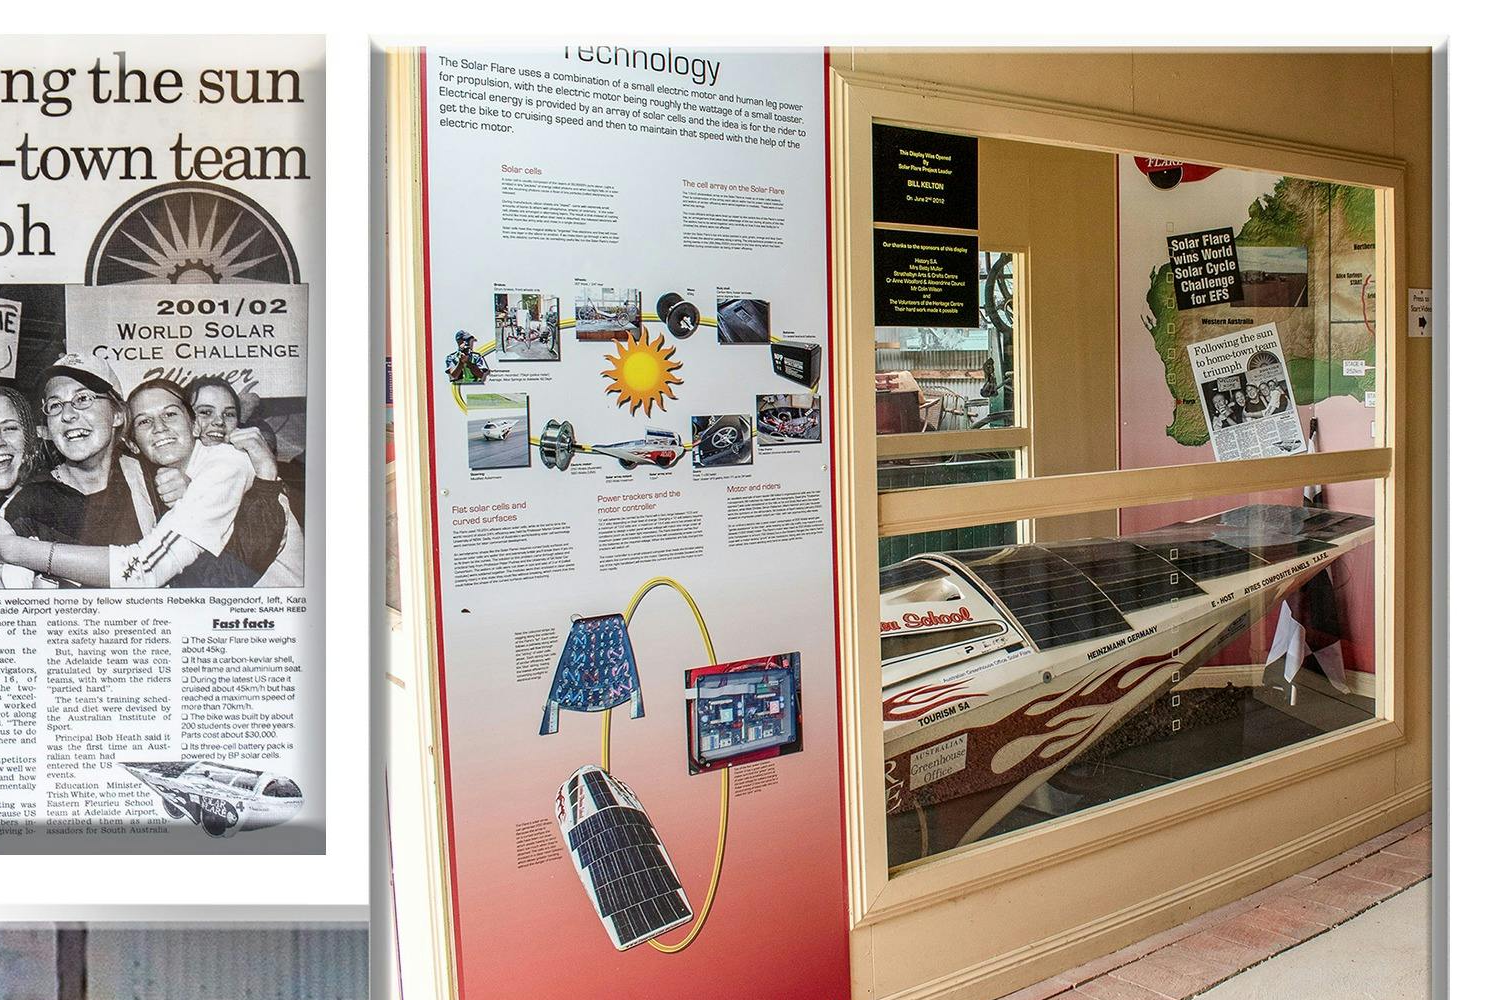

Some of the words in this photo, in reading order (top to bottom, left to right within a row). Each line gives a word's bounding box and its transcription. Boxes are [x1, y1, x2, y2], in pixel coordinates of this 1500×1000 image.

[87, 51, 183, 104] the
[199, 69, 304, 104] sun
[438, 55, 458, 67] The
[460, 58, 488, 70] Solar
[490, 62, 515, 74] Flare
[518, 68, 541, 78] uses
[543, 71, 550, 79] a
[552, 72, 609, 86] combination
[611, 78, 621, 87] of
[623, 81, 629, 89] a
[631, 82, 654, 92] small
[656, 84, 689, 96] electric
[690, 90, 717, 100] motor
[718, 94, 734, 102] and
[735, 94, 764, 106] human
[765, 98, 777, 110] leg
[778, 102, 803, 111] power
[169, 132, 311, 182] team
[501, 164, 523, 173] Solar
[524, 167, 542, 175] cells
[682, 179, 695, 187] The
[709, 183, 727, 192] array
[738, 184, 749, 192] the
[750, 184, 768, 193] Solar
[768, 186, 785, 195] Flare
[1171, 238, 1200, 251] Solar
[1202, 232, 1231, 246] Flare
[1174, 252, 1199, 265] wins
[1201, 245, 1233, 260] World
[1175, 267, 1203, 280] Solar
[1206, 260, 1236, 276] Cycle
[1181, 274, 1235, 293] Challenge
[1191, 293, 1206, 305] for
[1209, 288, 1229, 302] EFS
[157, 297, 287, 317] 2001/02
[116, 323, 192, 340] WORLD
[204, 321, 274, 338] SOLAR
[93, 345, 163, 361] CYCLE
[175, 343, 299, 359] CHALLENGE
[1194, 338, 1239, 356] Following
[1239, 333, 1256, 345] the
[1257, 329, 1273, 339] sun
[1196, 358, 1206, 368] to
[1206, 347, 1254, 367] home-town
[1255, 341, 1277, 353] team
[1203, 361, 1242, 379] triumph
[748, 483, 761, 491] and
[761, 482, 781, 490] riders
[597, 495, 621, 503] Power
[622, 492, 653, 501] trackers
[654, 490, 667, 499] and
[451, 505, 468, 514] Flat
[469, 504, 491, 513] solar
[491, 502, 510, 511] cells
[511, 501, 526, 509] and
[452, 516, 480, 526] curved
[482, 514, 517, 523] surfaces
[1244, 581, 1262, 595] AYRES
[1261, 569, 1291, 587] COMPOSITE
[1291, 561, 1310, 574] PANELS
[4, 597, 50, 605] welcomed
[53, 597, 79, 605] home
[82, 597, 93, 606] by
[96, 597, 122, 605] fellow
[166, 596, 205, 604] Rebekka
[209, 596, 263, 606] Baggendorf,
[266, 596, 282, 604] left,
[286, 596, 307, 604] Kara
[212, 618, 240, 628] Fast
[242, 617, 275, 628] facts
[903, 607, 973, 629] School
[1087, 635, 1126, 660] HEINZMANN
[1127, 625, 1158, 644] GERMANY
[918, 706, 956, 727] TOURISM
[958, 701, 970, 714] SA
[914, 737, 964, 762] AUSTRALIAN
[911, 748, 966, 776] Greenhouse
[924, 767, 952, 784] Office
